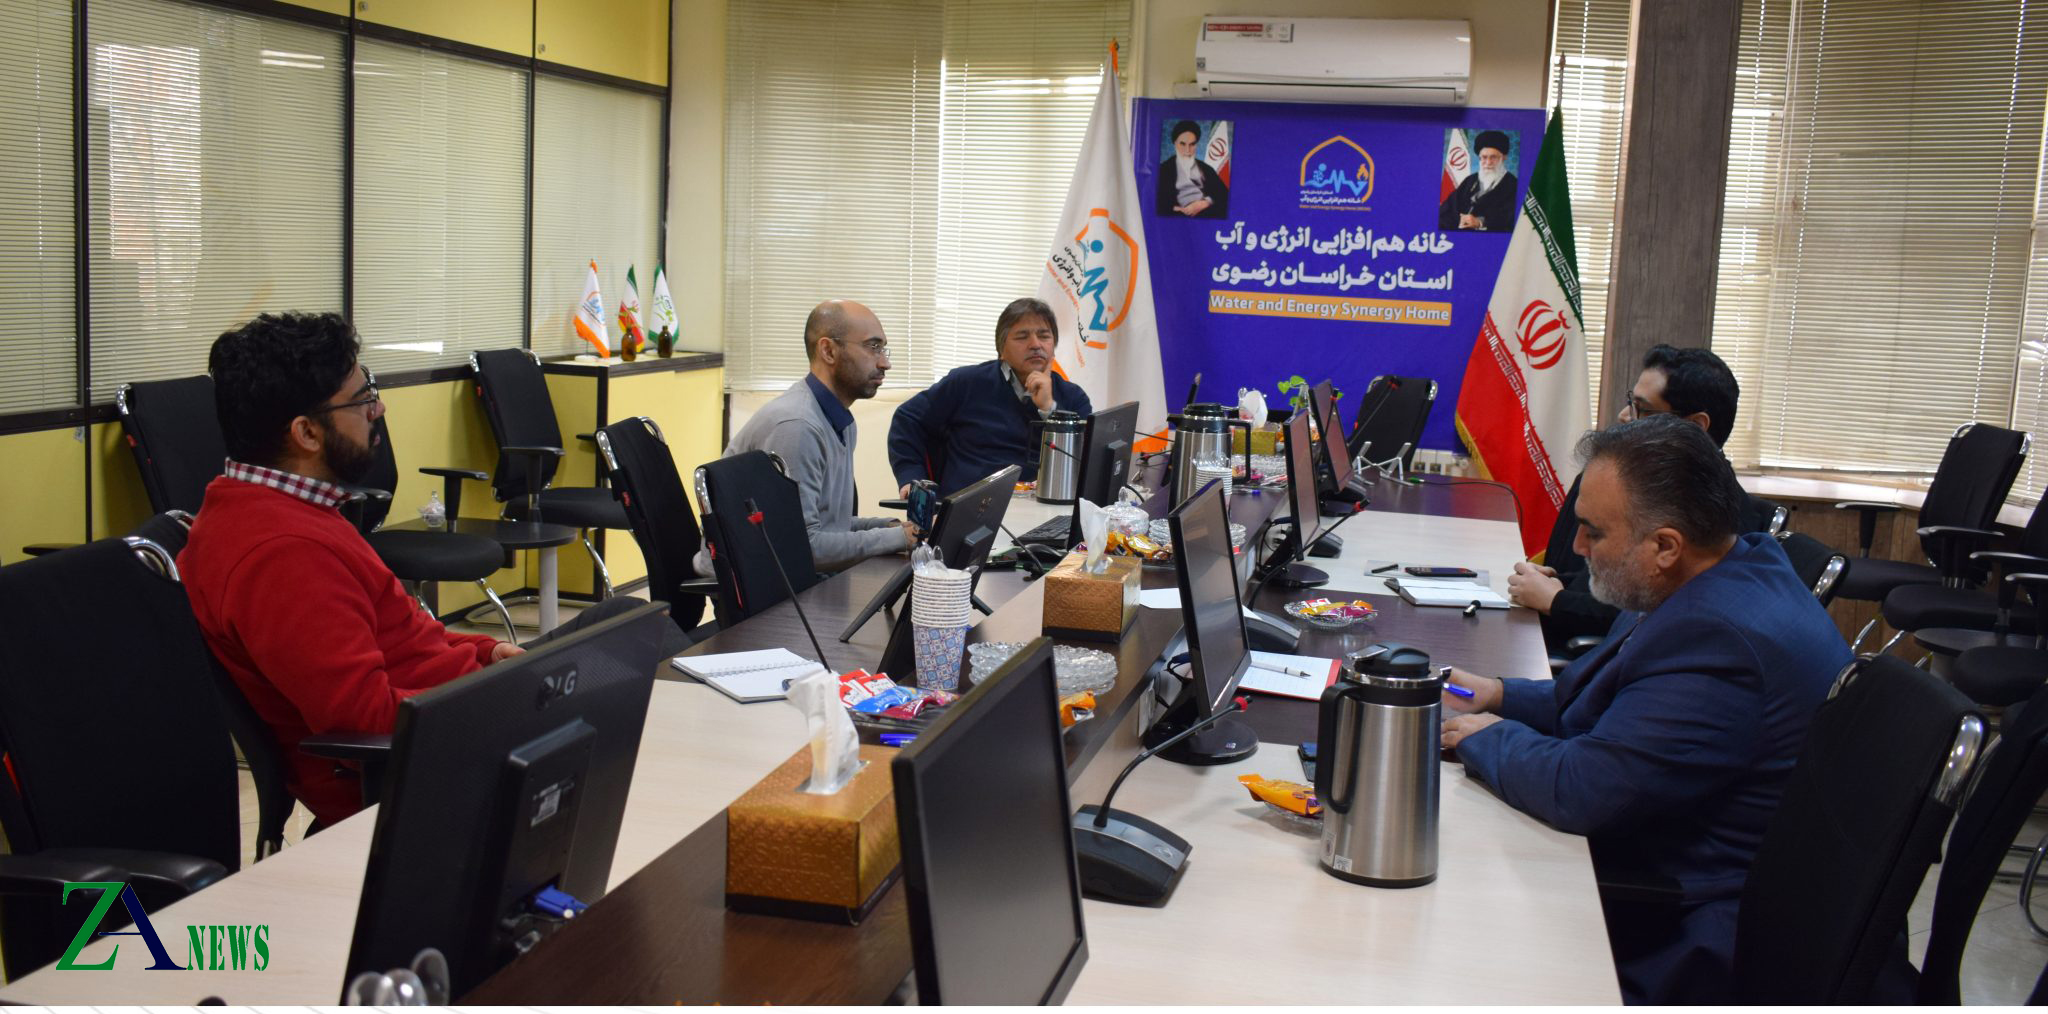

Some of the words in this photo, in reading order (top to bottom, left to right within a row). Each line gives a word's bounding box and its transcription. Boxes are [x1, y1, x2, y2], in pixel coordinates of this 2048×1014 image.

[1215, 221, 1245, 251] آب
[1245, 231, 1258, 251] و
[1260, 225, 1310, 252] انرژی
[1408, 231, 1454, 254] خانه
[1212, 260, 1277, 287] رضوی
[1280, 261, 1376, 291] خراسان
[1378, 266, 1454, 291] استان
[1210, 295, 1254, 310] Water
[1257, 298, 1283, 311] and
[1287, 299, 1339, 317] Energy
[1341, 302, 1403, 321] Synergy
[1405, 304, 1450, 321] Home
